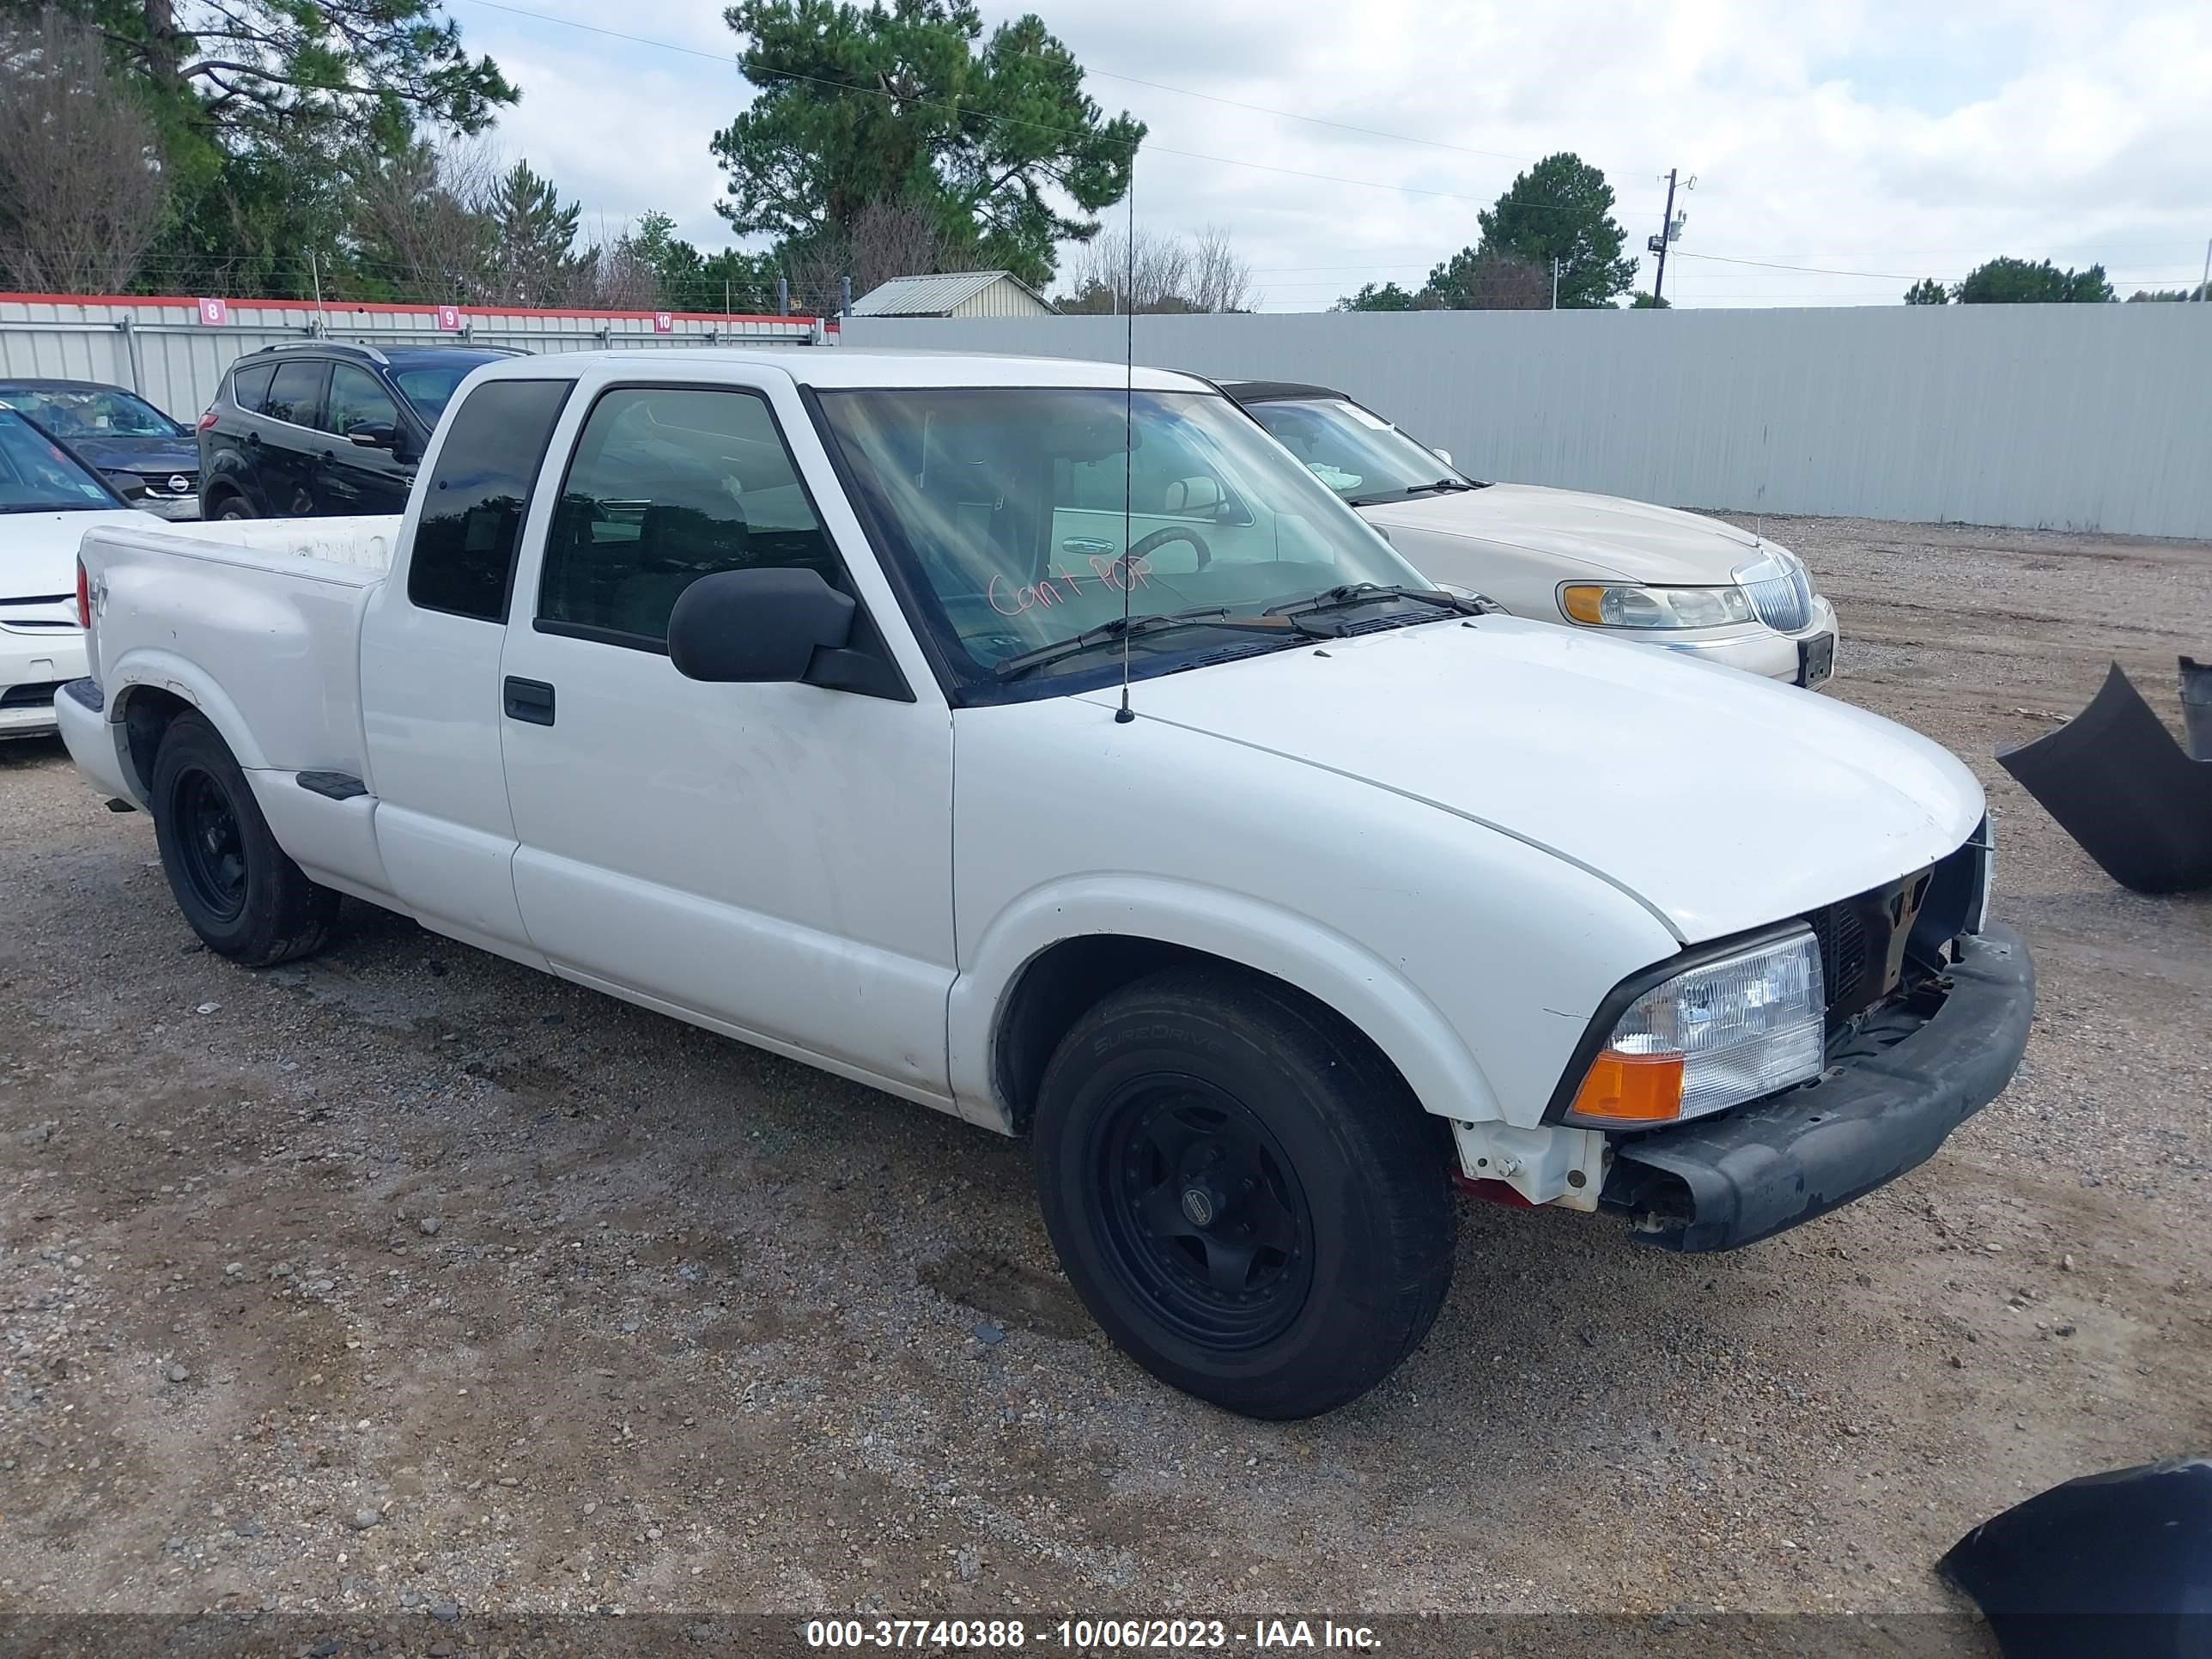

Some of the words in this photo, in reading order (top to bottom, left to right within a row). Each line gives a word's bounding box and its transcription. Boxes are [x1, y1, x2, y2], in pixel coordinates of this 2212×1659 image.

[208, 303, 219, 320] 8
[446, 311, 454, 326] 9
[659, 315, 670, 329] 10
[1089, 556, 1152, 592] POP
